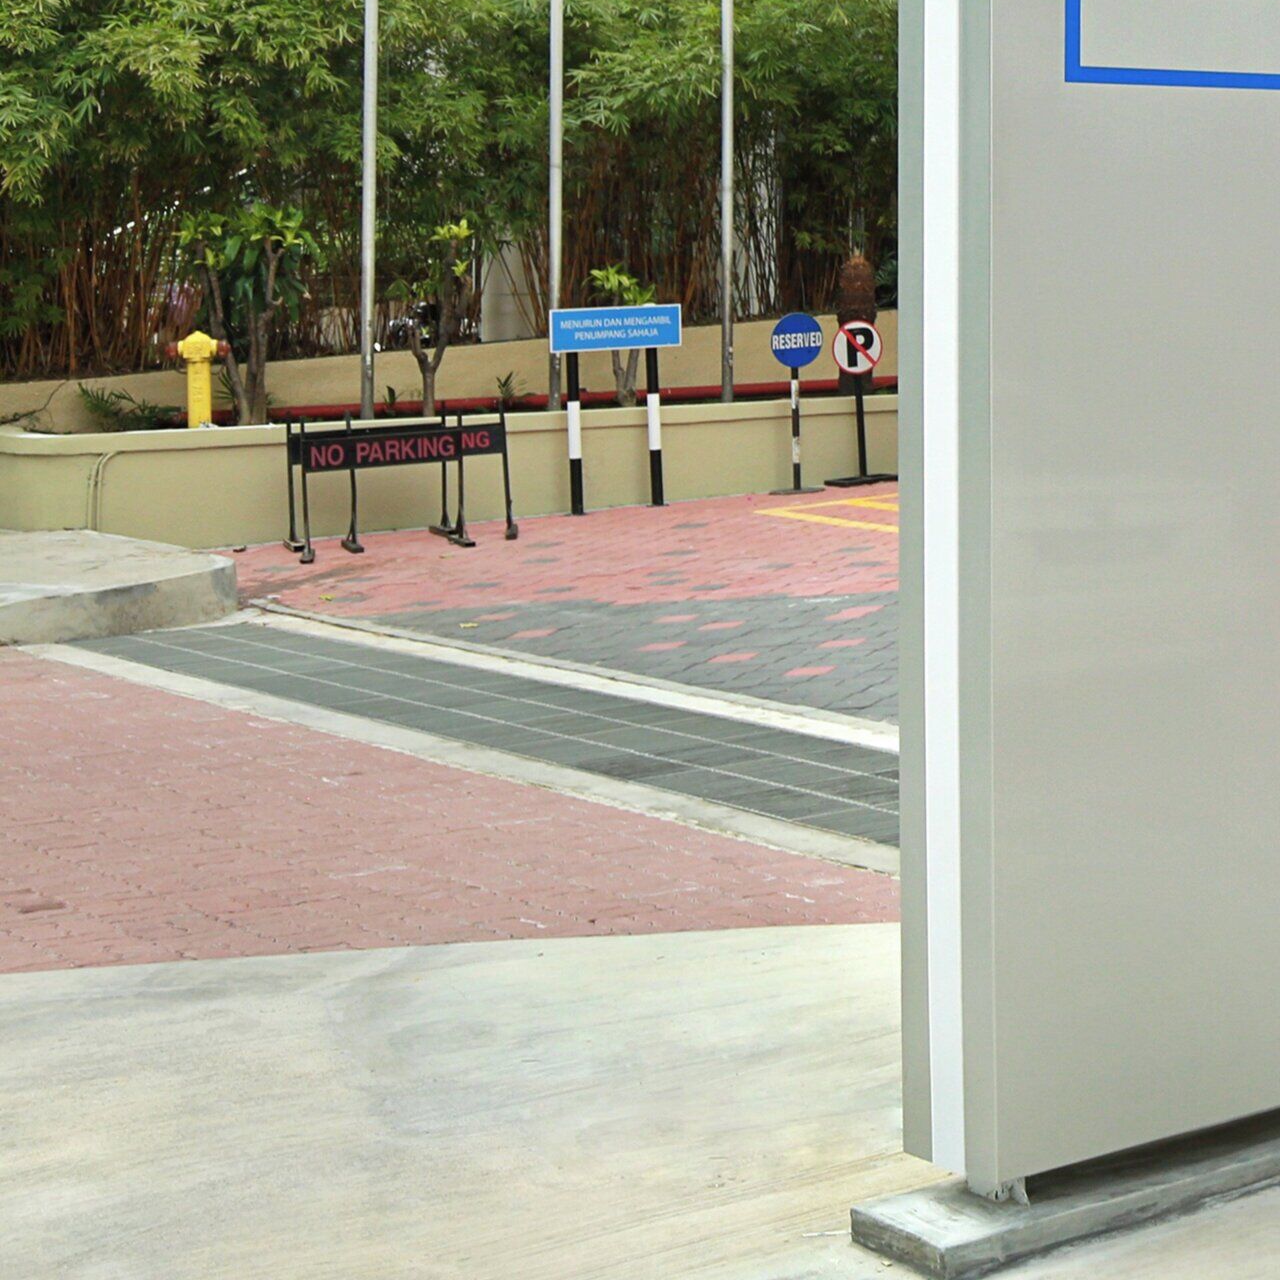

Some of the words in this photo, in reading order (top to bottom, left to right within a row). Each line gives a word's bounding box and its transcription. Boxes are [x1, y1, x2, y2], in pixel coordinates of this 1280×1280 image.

[560, 318, 602, 329] MENURUN
[603, 317, 623, 327] DAN
[624, 315, 671, 326] MENGAMBIL
[574, 330, 626, 340] PENUMPANG
[627, 328, 659, 337] SAHAJA
[772, 331, 822, 350] RESERVED
[846, 327, 874, 368] P
[310, 444, 344, 467] NO
[356, 435, 455, 464] PARKING
